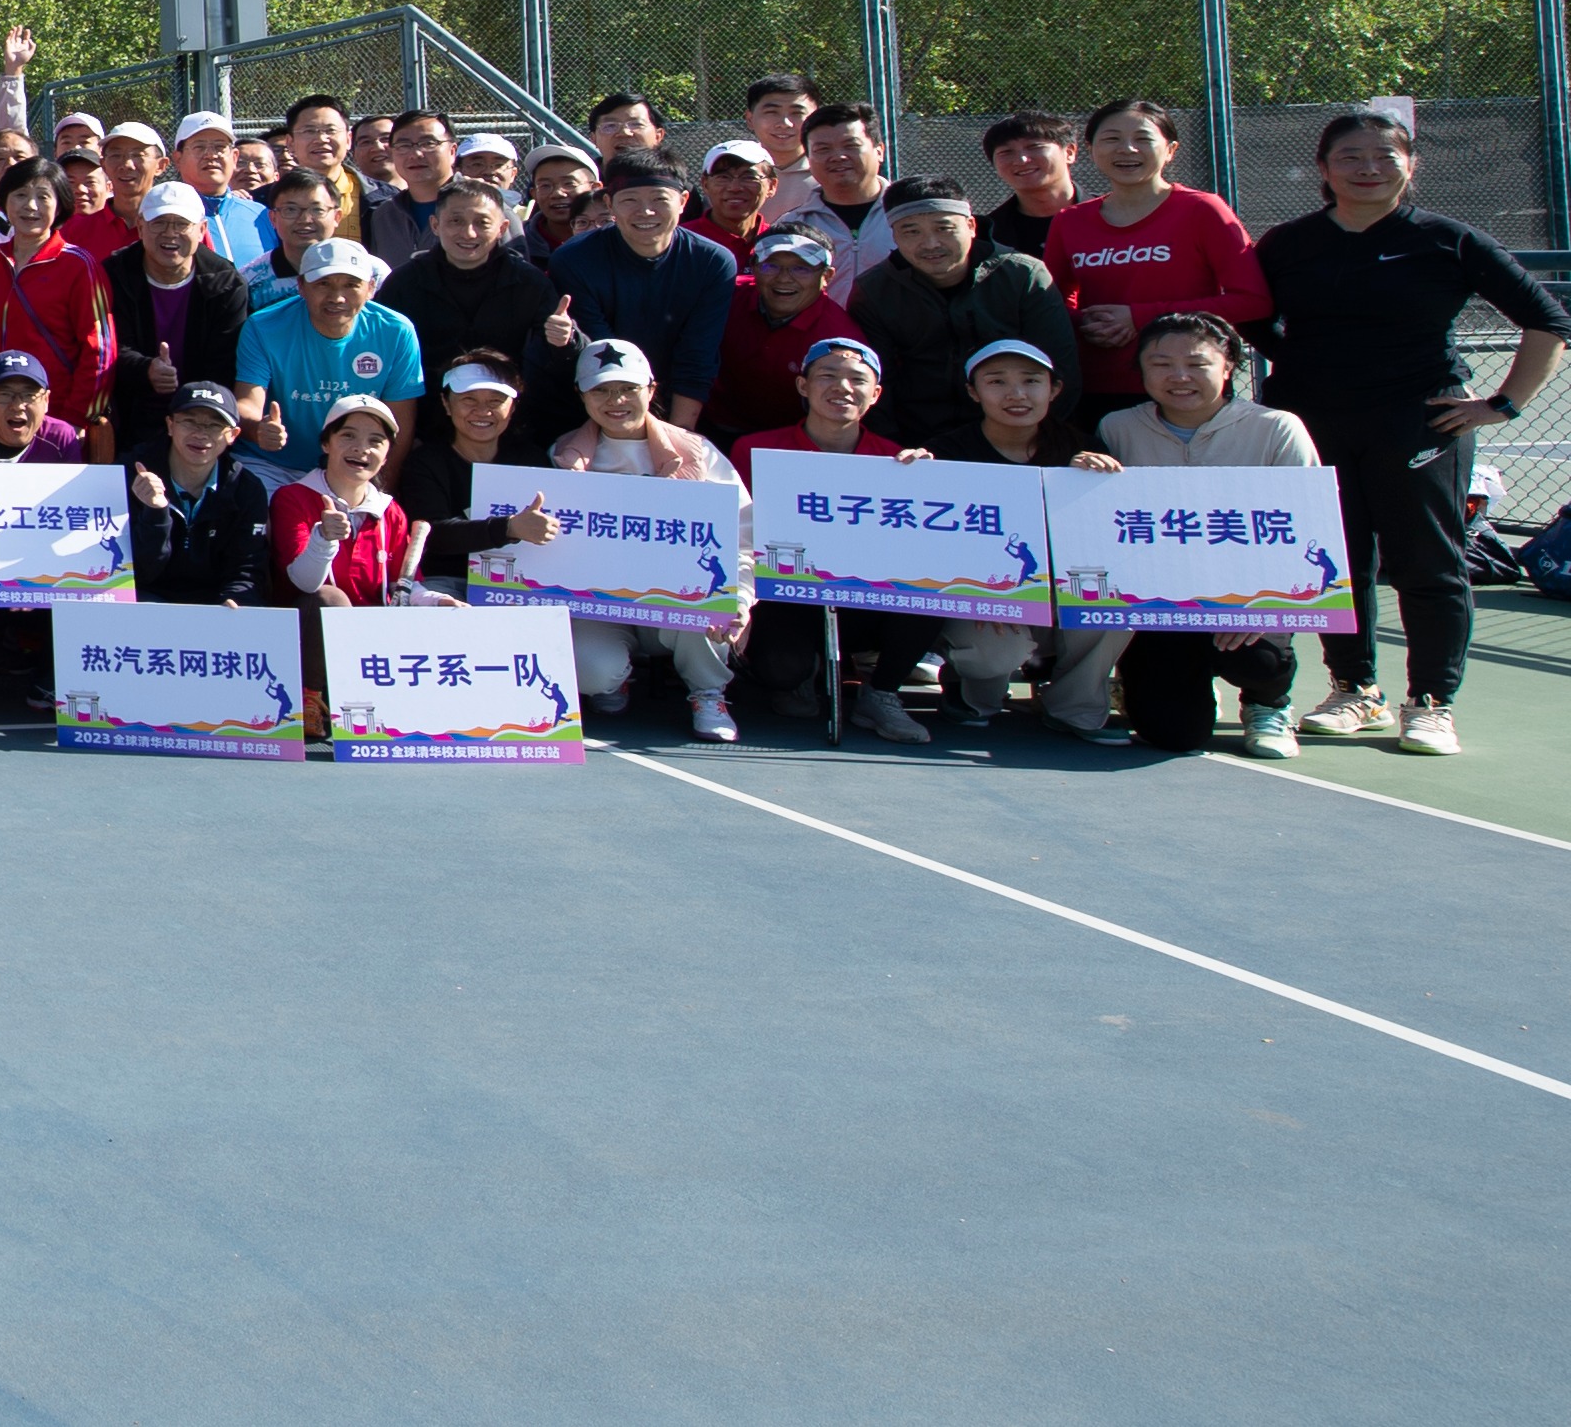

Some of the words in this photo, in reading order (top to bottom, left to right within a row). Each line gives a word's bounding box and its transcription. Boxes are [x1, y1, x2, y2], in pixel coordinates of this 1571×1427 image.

[1072, 244, 1171, 268] adidas
[192, 389, 224, 404] FILA
[489, 503, 722, 550] 建学院网球队
[797, 491, 1005, 536] 电子系乙组
[1114, 508, 1296, 547] 清华美院
[484, 591, 525, 606] 2023
[668, 612, 710, 627] 校庆站
[774, 584, 818, 600] 2023
[820, 586, 973, 616] 全球清华校友网球联赛
[976, 601, 1022, 619] 校庆站
[1080, 612, 1125, 626] 2023
[1127, 612, 1278, 629] 全球清华校友网球联赛
[1282, 613, 1328, 629] 校庆站
[80, 644, 276, 680] 热汽系网球队
[360, 652, 547, 688] 电子系一队
[73, 730, 110, 745] 2023
[112, 733, 239, 754] 全球清华校友网球联赛
[241, 740, 281, 756] 校庆站
[351, 744, 388, 759] 2023
[390, 744, 518, 761] 全球清华校友网球联赛
[521, 744, 560, 760] 校庆站
